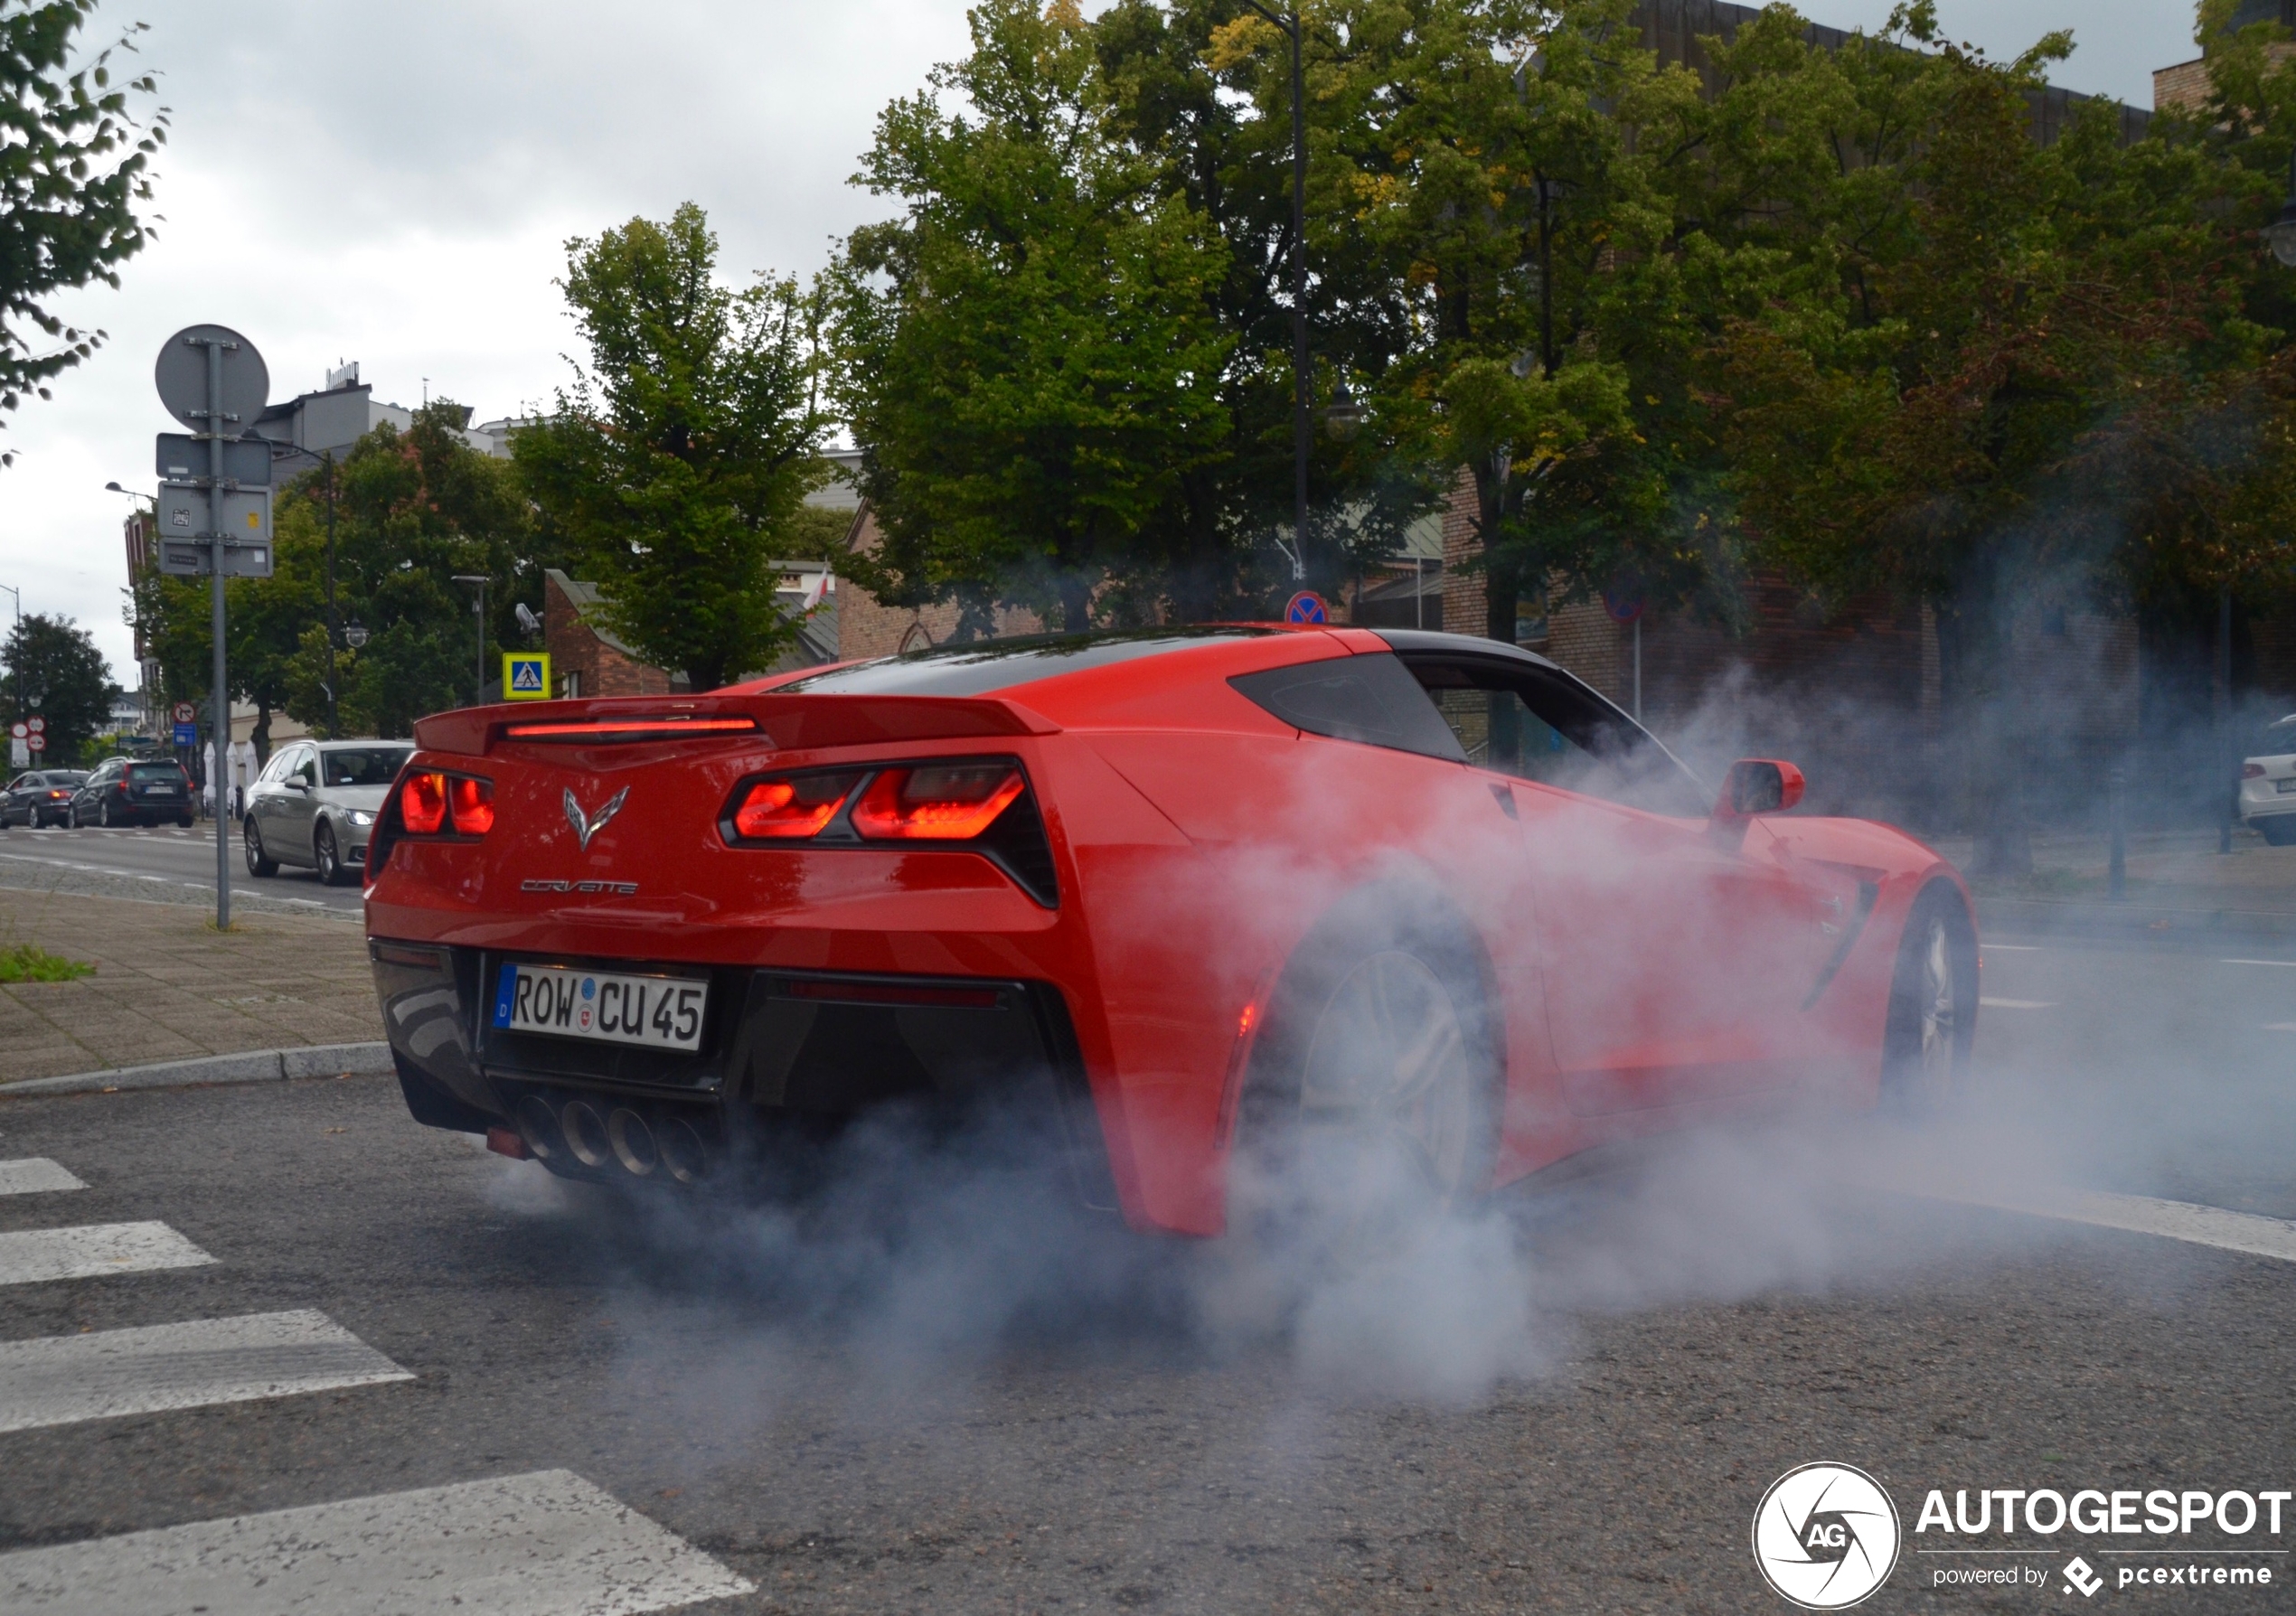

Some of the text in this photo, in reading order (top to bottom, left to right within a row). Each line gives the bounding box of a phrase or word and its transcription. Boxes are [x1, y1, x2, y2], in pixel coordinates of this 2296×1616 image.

[521, 879, 638, 894] CORVETTE
[500, 1003, 508, 1018] D
[512, 974, 702, 1041] ROW CU 45
